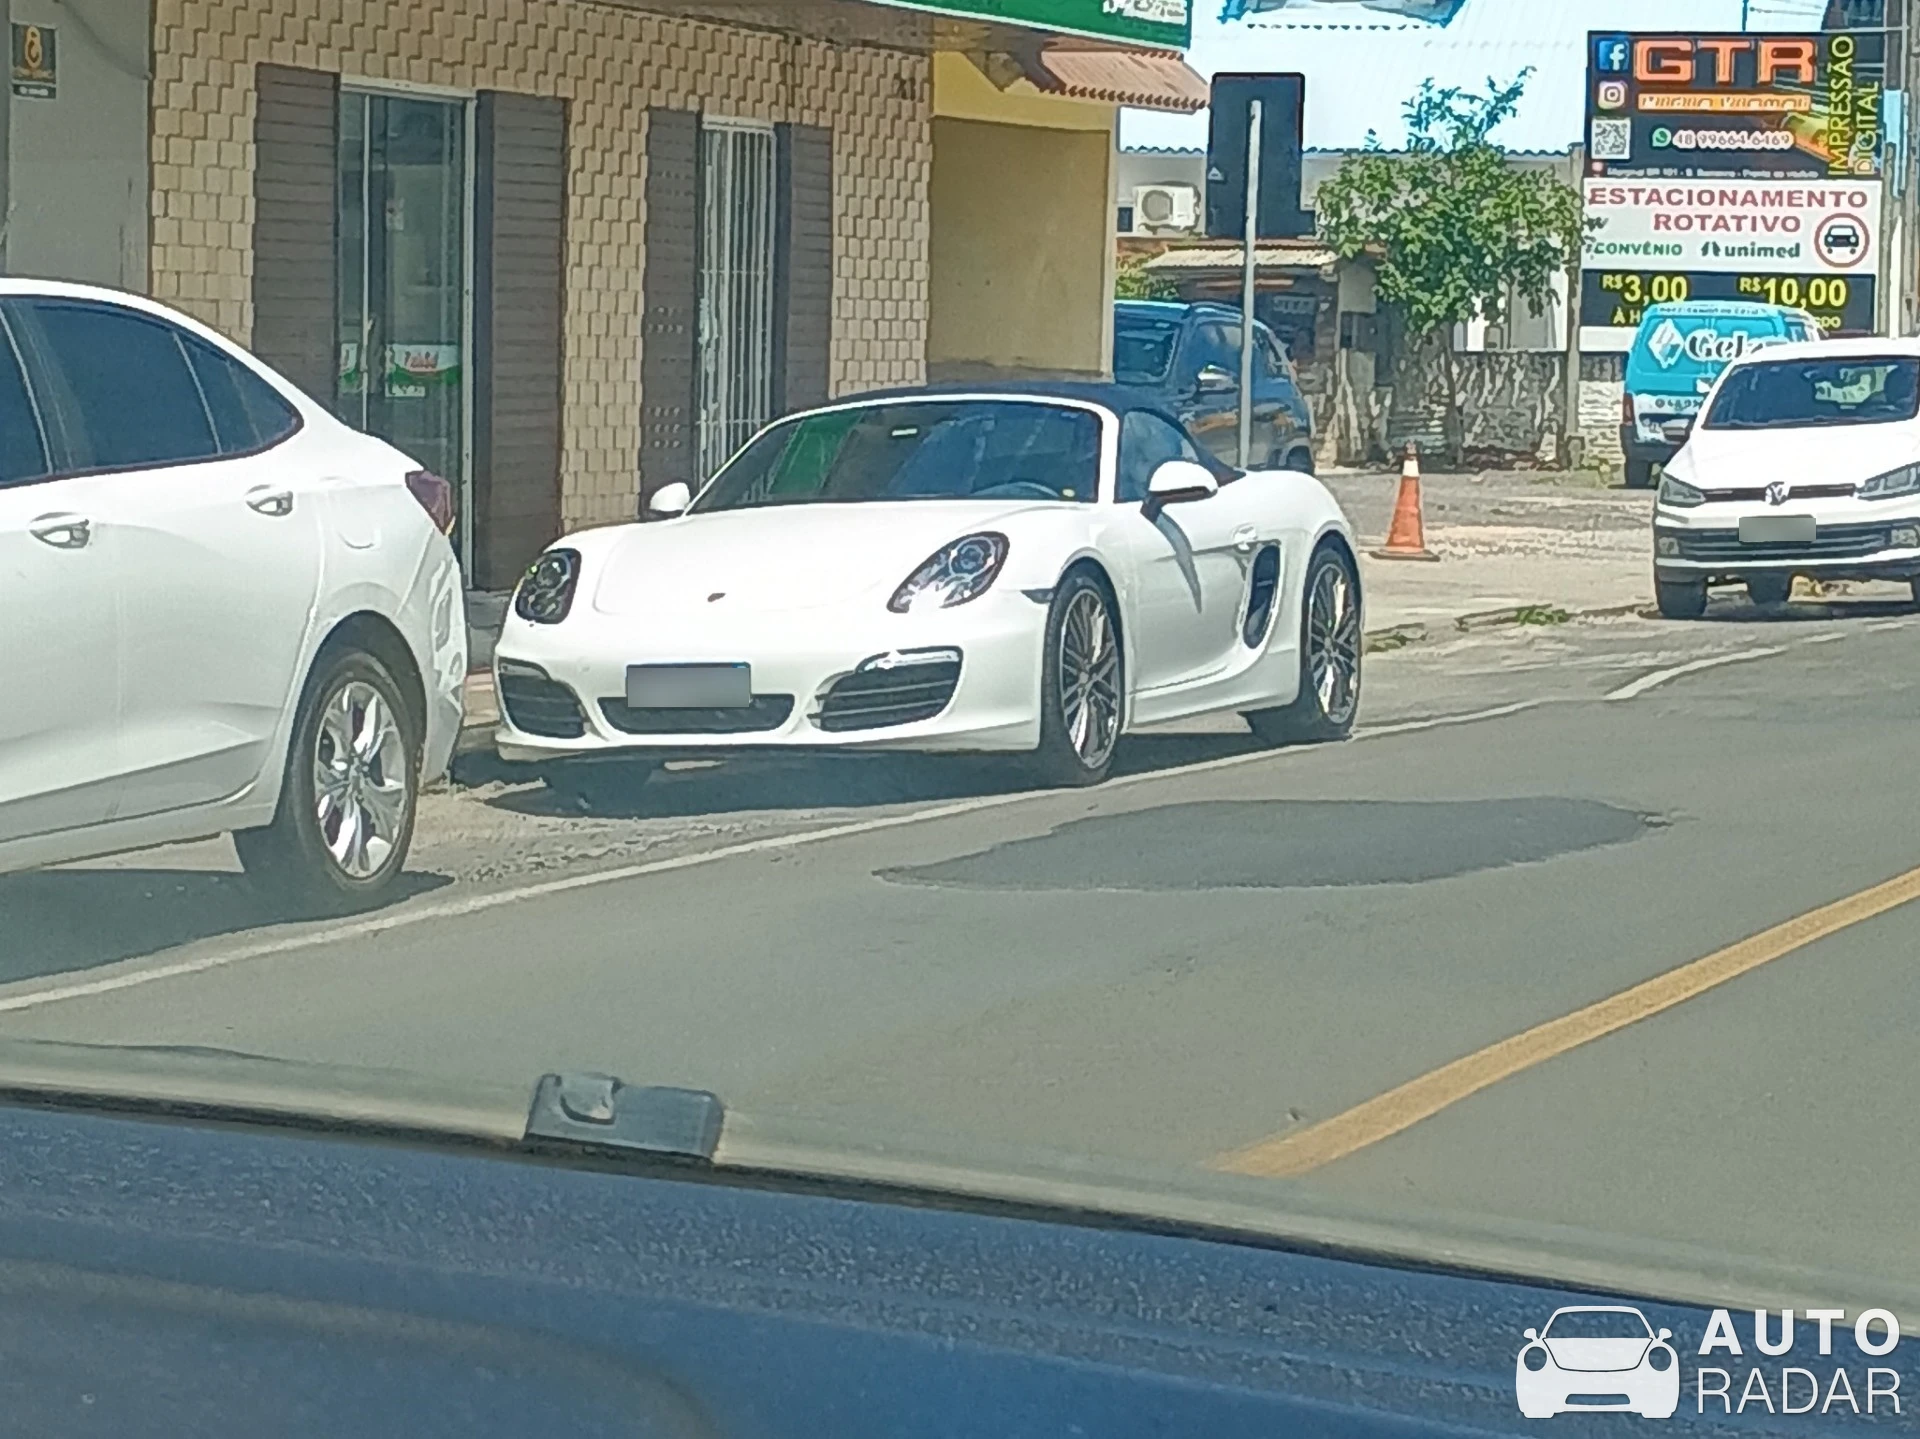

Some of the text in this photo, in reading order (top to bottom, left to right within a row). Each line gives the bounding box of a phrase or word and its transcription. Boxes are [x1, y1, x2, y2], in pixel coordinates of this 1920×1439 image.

[1634, 39, 1817, 84] GTR
[1827, 36, 1854, 175] IMPRESSÃO
[1853, 81, 1879, 175] DIGITAL
[1588, 187, 1868, 208] ESTACIONAMENTO
[1653, 213, 1801, 233] ROTATIVO
[1593, 241, 1801, 258] CONVÊNIO unimed
